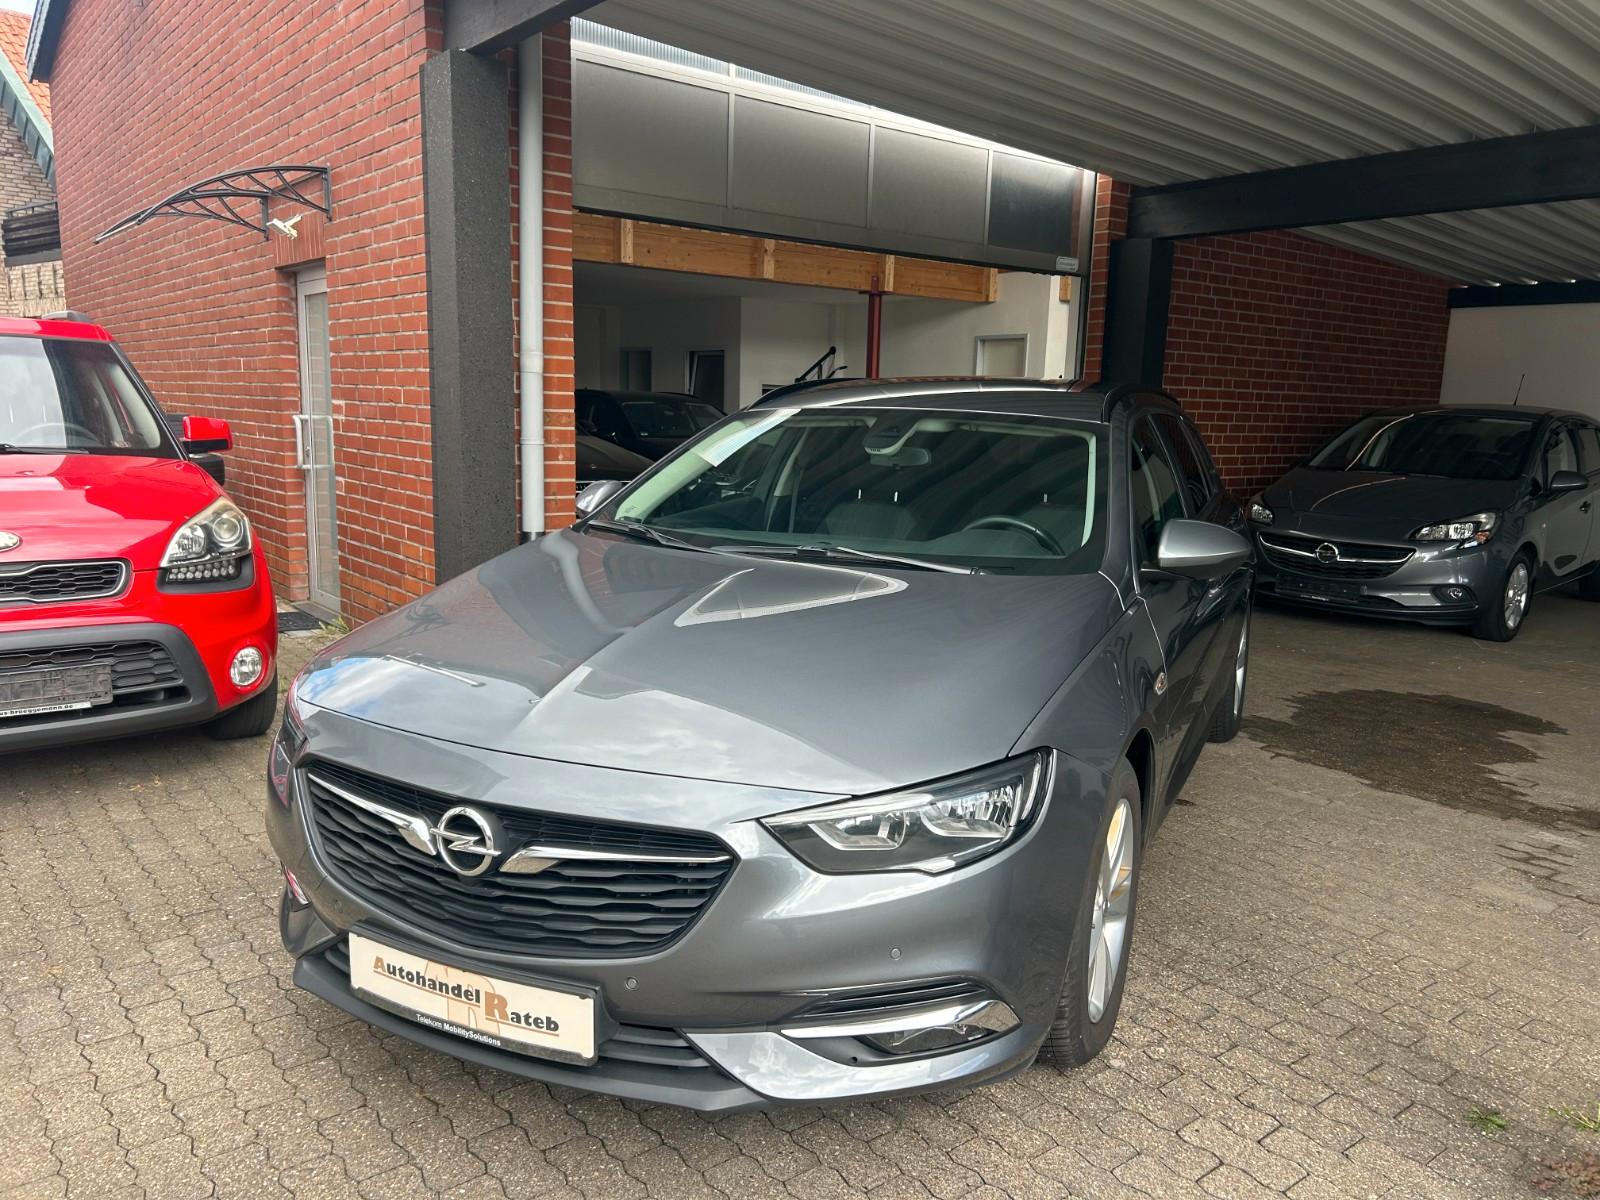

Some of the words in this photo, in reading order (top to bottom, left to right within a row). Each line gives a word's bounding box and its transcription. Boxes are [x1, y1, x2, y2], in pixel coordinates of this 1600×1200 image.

[373, 955, 481, 1004] Autohandel
[484, 990, 560, 1033] Rateb
[416, 1013, 442, 1029] Telekom
[443, 1022, 501, 1047] MobilitySolutions
